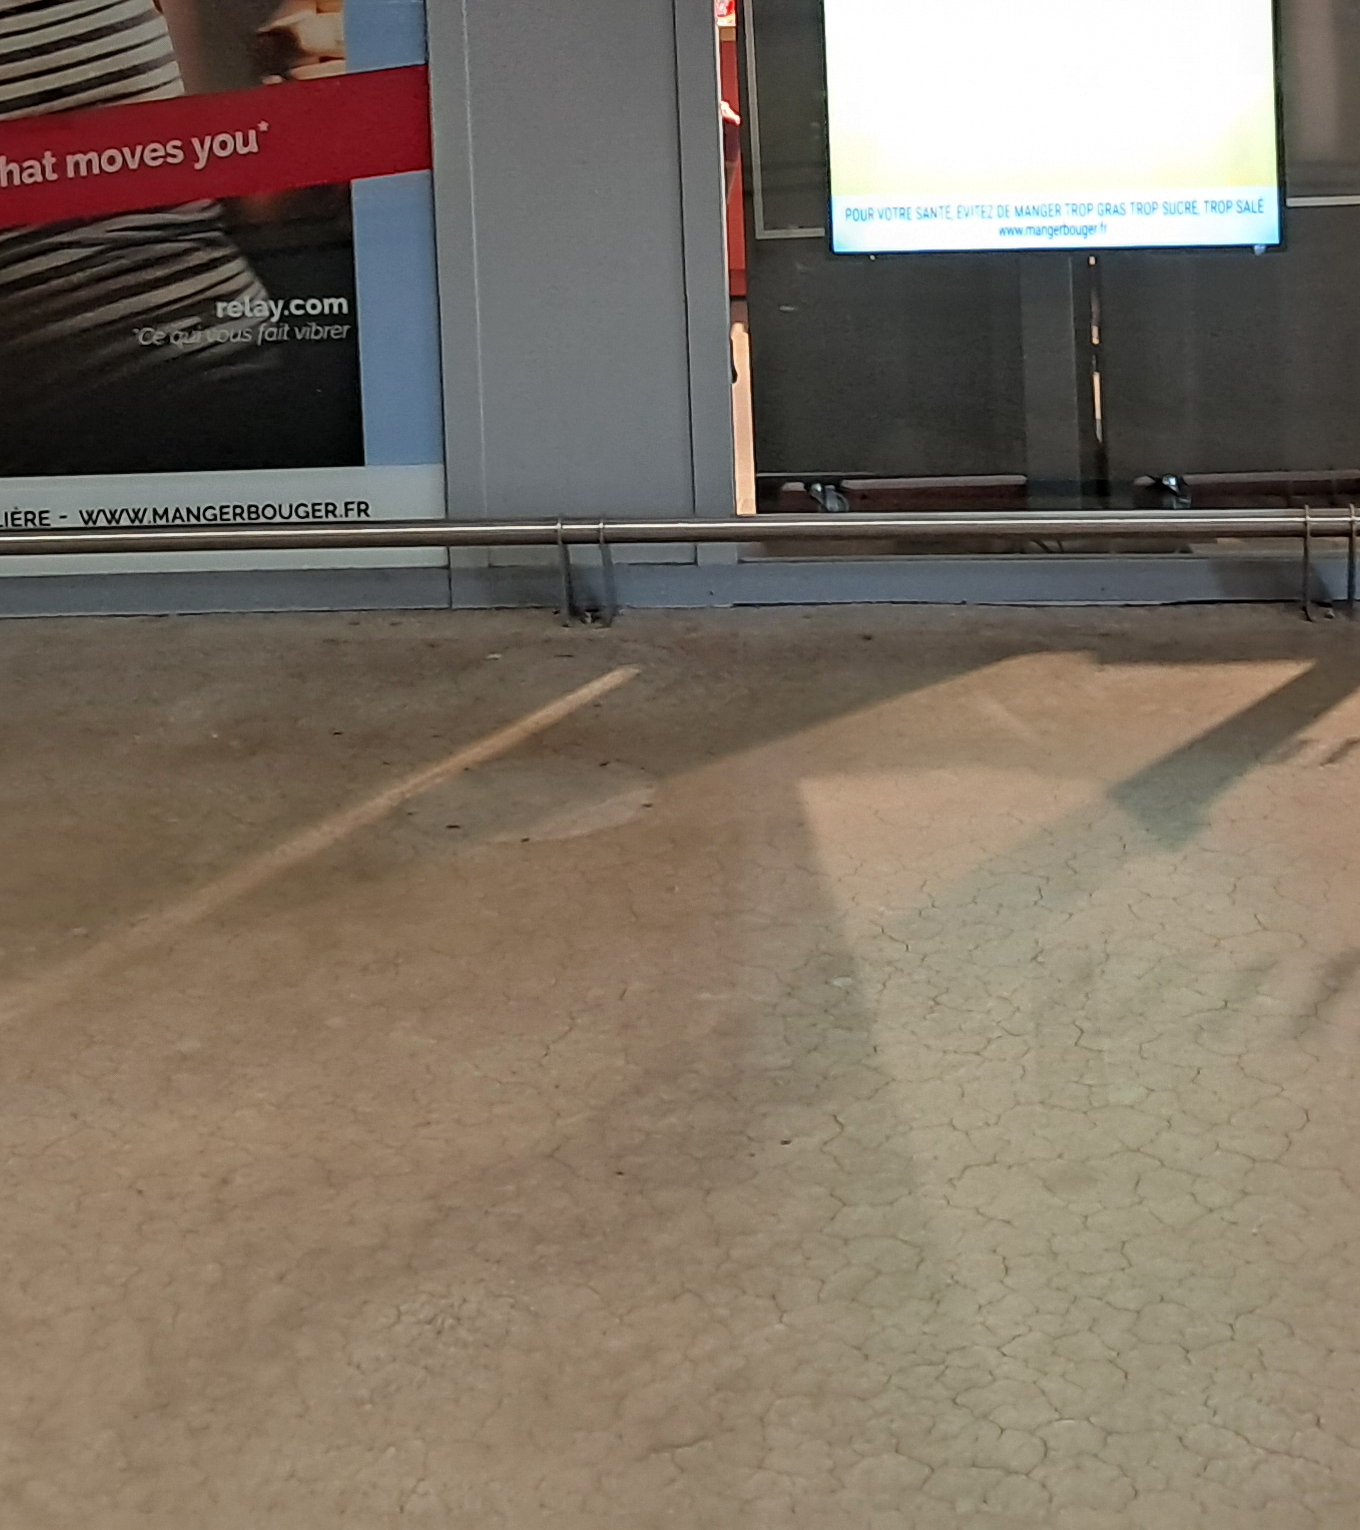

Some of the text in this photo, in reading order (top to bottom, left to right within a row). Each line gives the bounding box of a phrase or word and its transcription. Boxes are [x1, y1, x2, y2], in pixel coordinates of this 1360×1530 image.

[66, 139, 185, 179] moves
[845, 207, 874, 222] POUR
[878, 206, 913, 221] VOTRE
[997, 204, 1010, 219] DE
[1014, 202, 1062, 218] MANGER
[1065, 202, 1094, 218] TROP
[1097, 202, 1126, 217] GRAS
[1130, 201, 1159, 216] TROP
[1204, 200, 1233, 215] TROP
[1236, 198, 1265, 214] SALÉ
[216, 296, 349, 323] relay.com
[257, 323, 291, 347] fait
[294, 322, 351, 341] vibrer
[78, 501, 371, 526] WWW.MANGERBOUGER.FR
